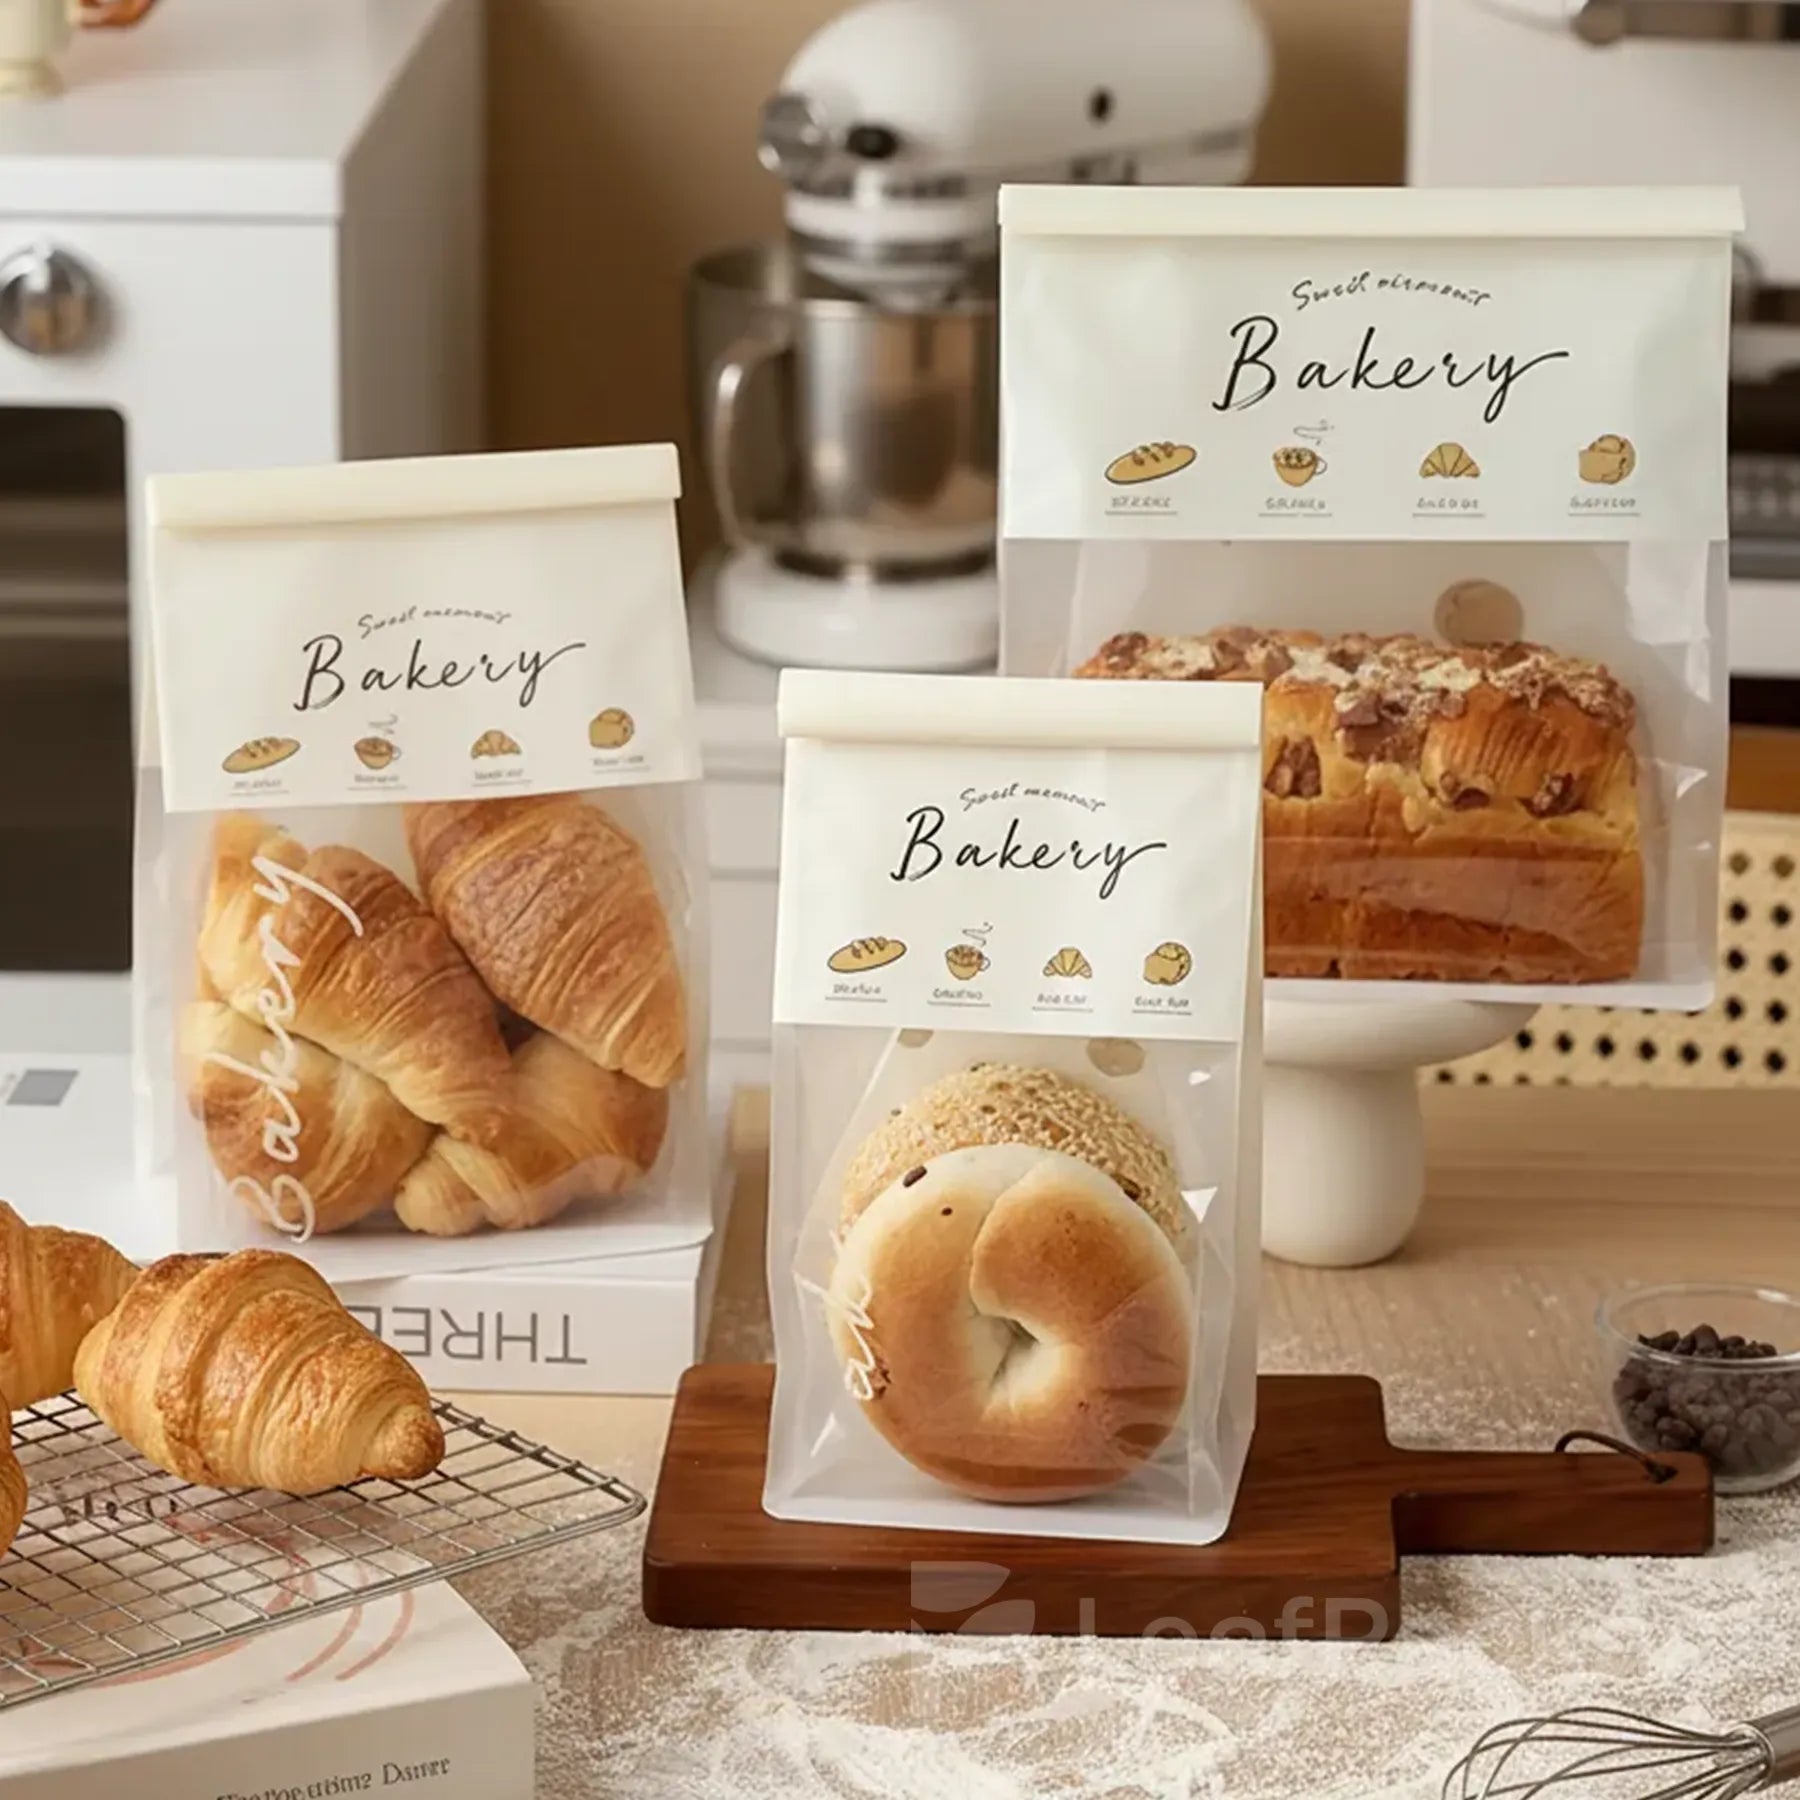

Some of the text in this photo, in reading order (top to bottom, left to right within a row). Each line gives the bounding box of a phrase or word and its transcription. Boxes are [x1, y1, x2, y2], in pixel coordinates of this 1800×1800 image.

[1212, 315, 1569, 424] Bakery
[293, 633, 586, 712] Bakery
[890, 805, 1167, 900] Bakery
[206, 856, 364, 1243] Bakery
